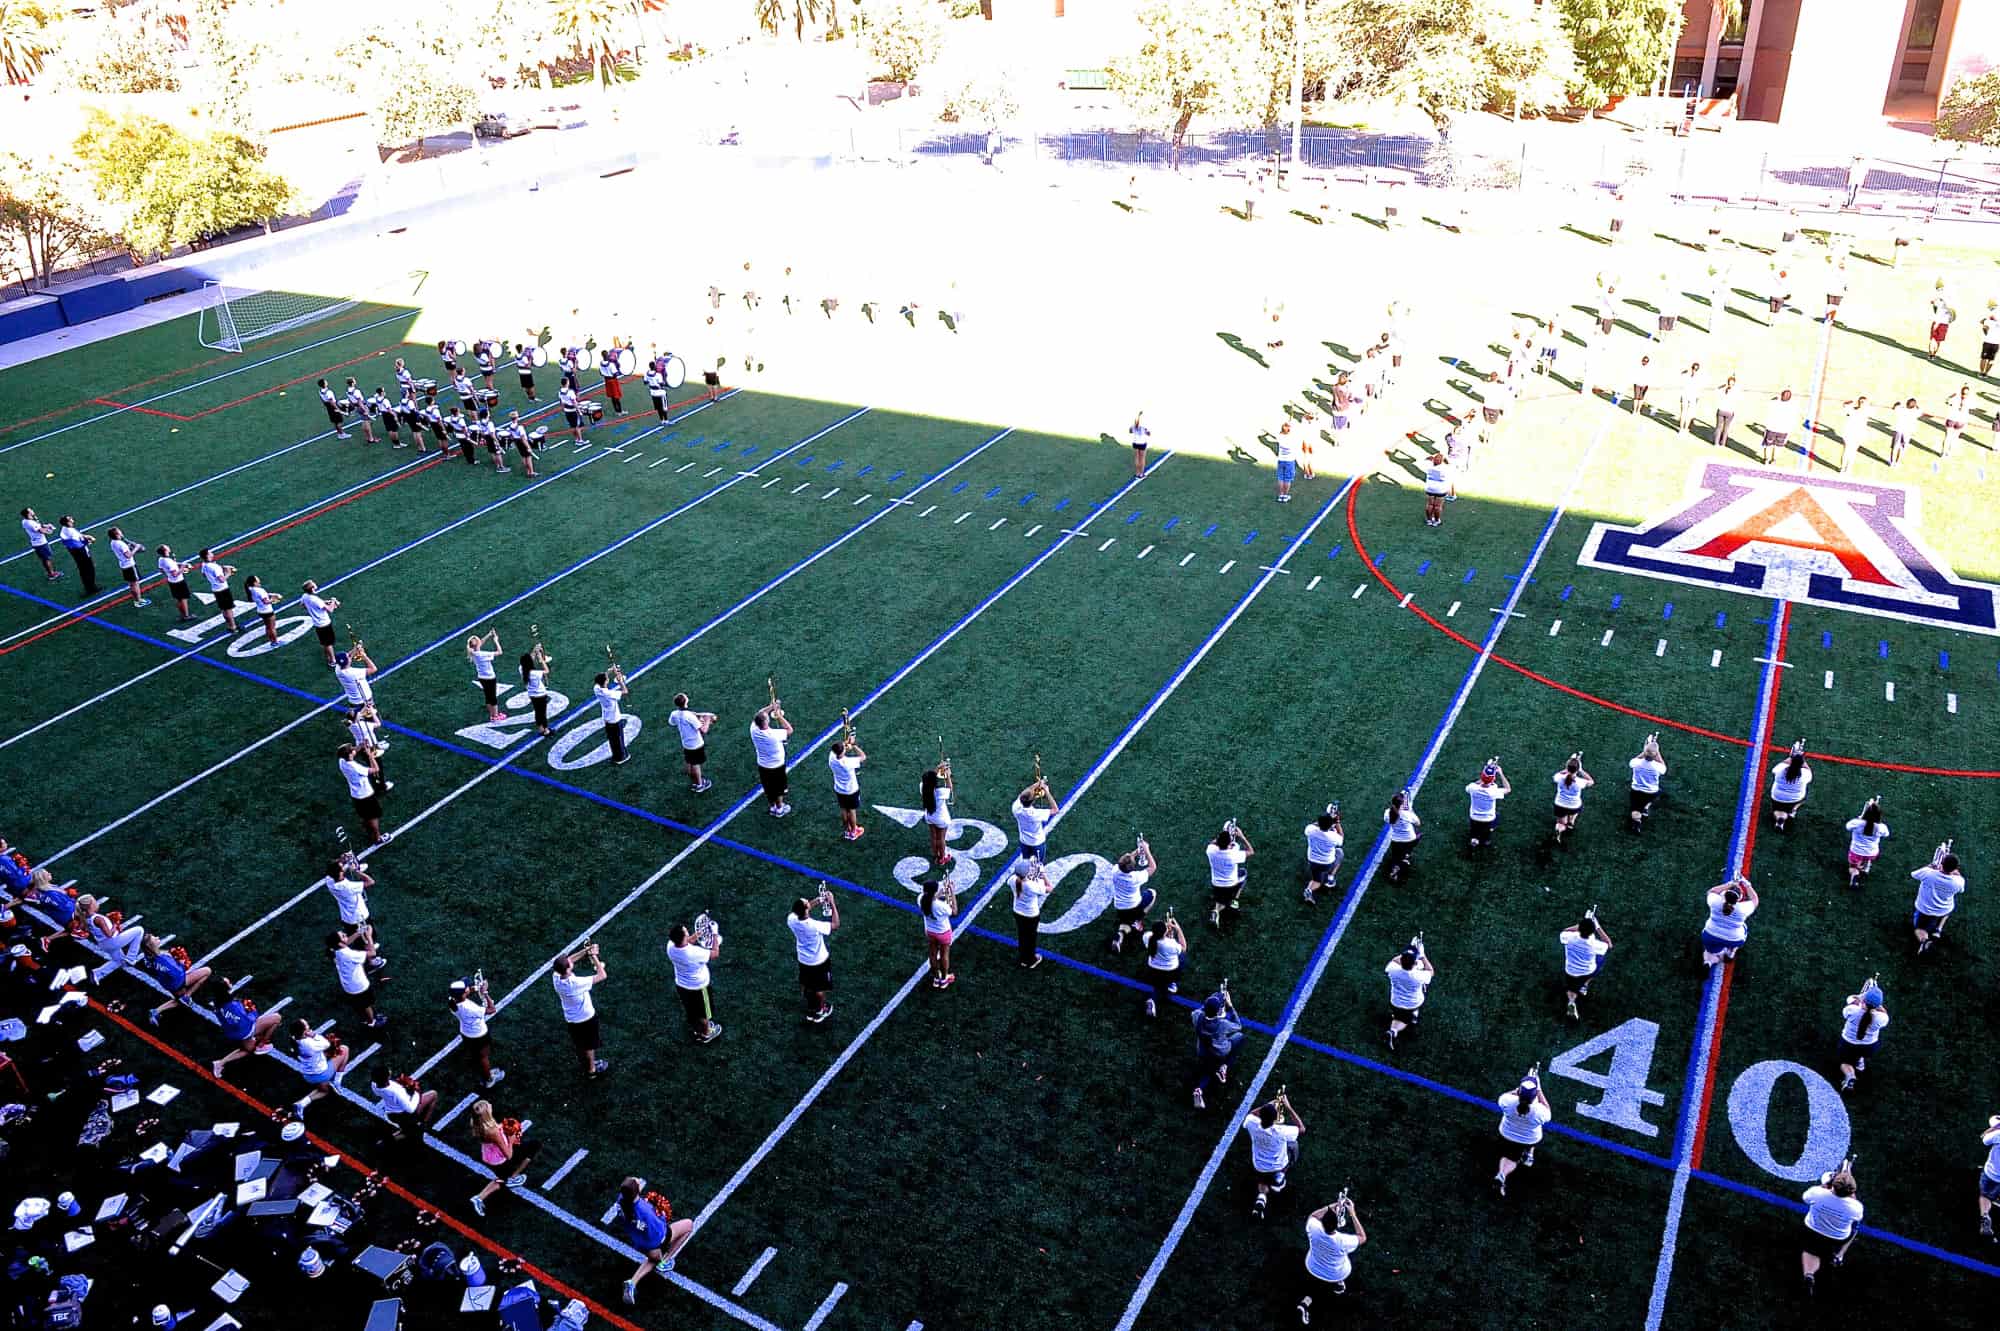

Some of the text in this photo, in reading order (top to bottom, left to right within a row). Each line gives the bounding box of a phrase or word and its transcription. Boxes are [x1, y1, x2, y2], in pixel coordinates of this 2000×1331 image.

[1578, 461, 2000, 637] A
[872, 804, 1114, 934] 30
[1549, 1017, 1851, 1182] 40
